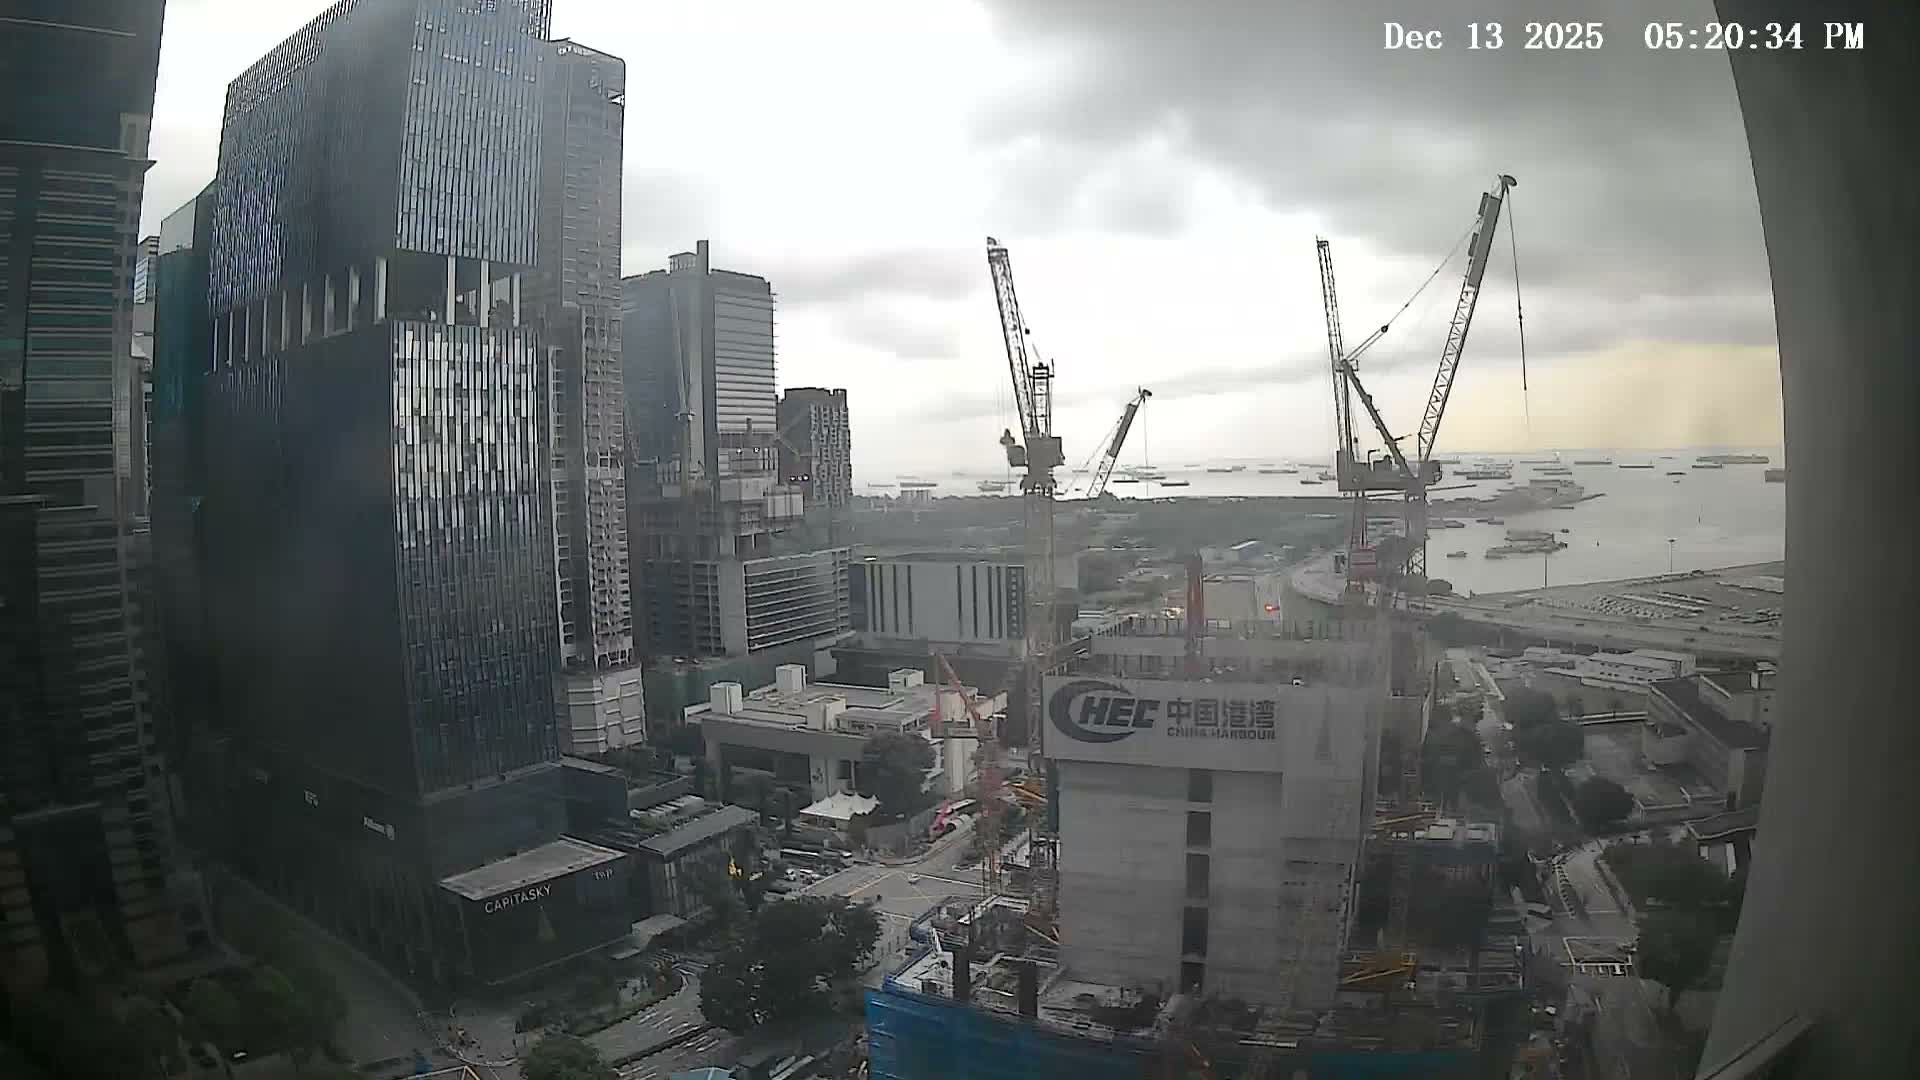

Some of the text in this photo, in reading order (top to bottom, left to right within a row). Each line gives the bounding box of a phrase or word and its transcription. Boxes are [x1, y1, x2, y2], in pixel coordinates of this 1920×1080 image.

[1166, 697, 1275, 728] 中国港湾
[1167, 726, 1276, 740] CHINA HARBOUR
[485, 884, 551, 913] CAPITASKY
